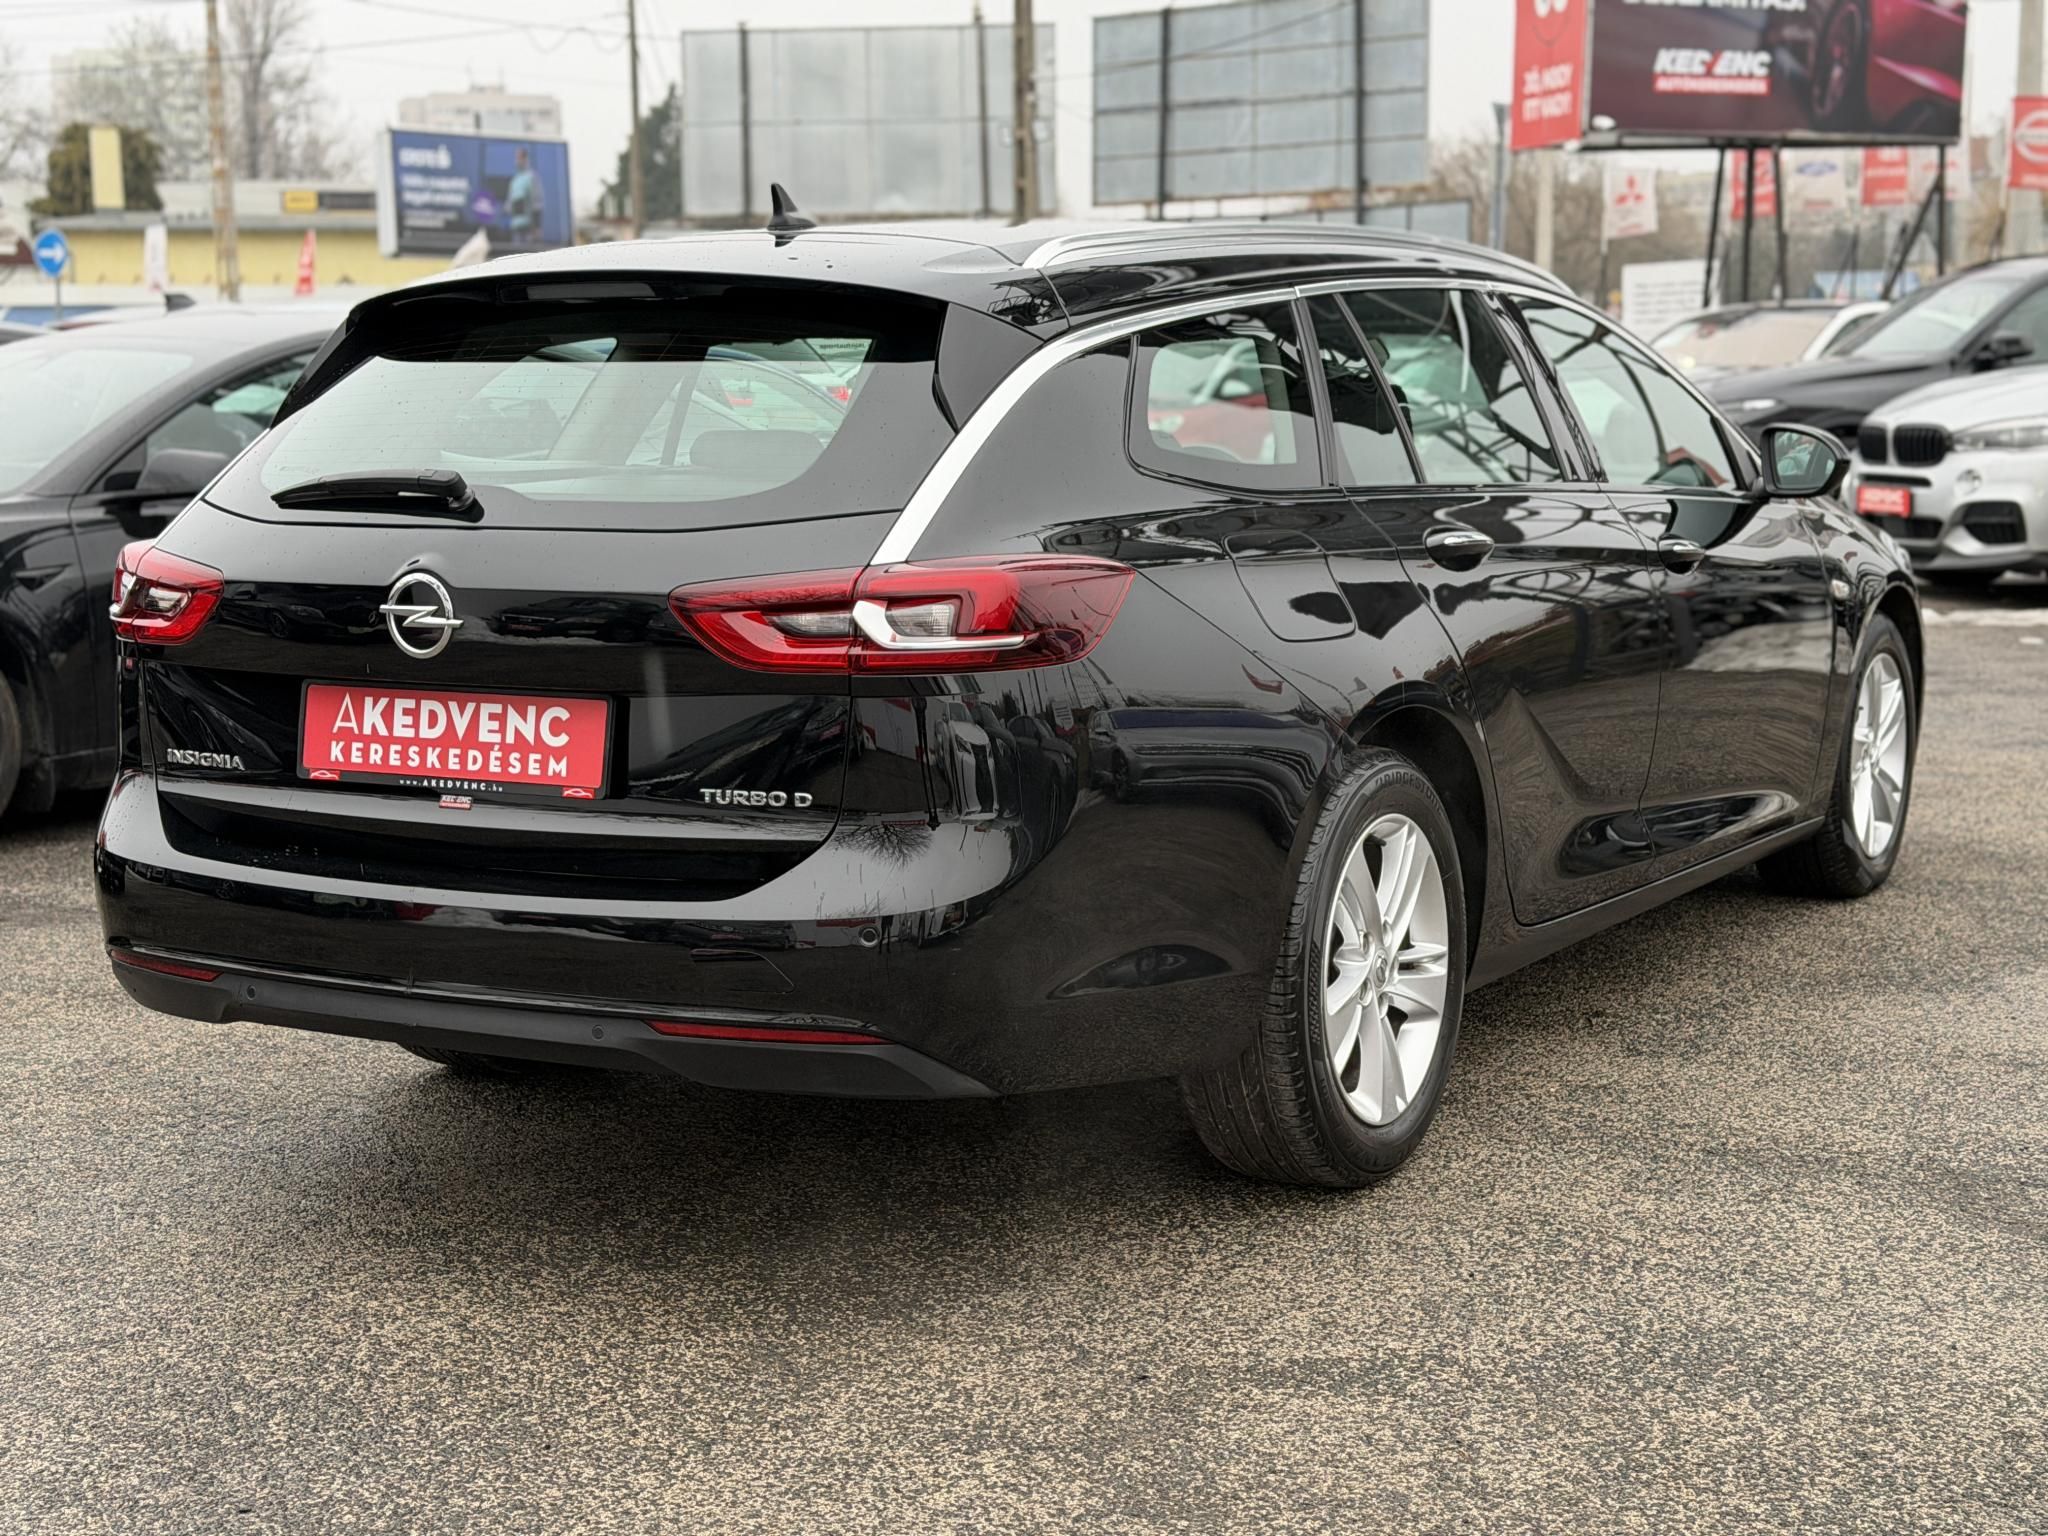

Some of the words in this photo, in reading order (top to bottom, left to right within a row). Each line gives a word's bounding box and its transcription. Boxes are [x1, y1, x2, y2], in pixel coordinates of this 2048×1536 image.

[167, 748, 246, 771] INSIGNIA
[330, 741, 568, 777] KERESKEDÉSEM
[399, 778, 503, 792] www.AKEDVENC.hu
[699, 788, 787, 806] TURBO
[794, 792, 813, 807] D
